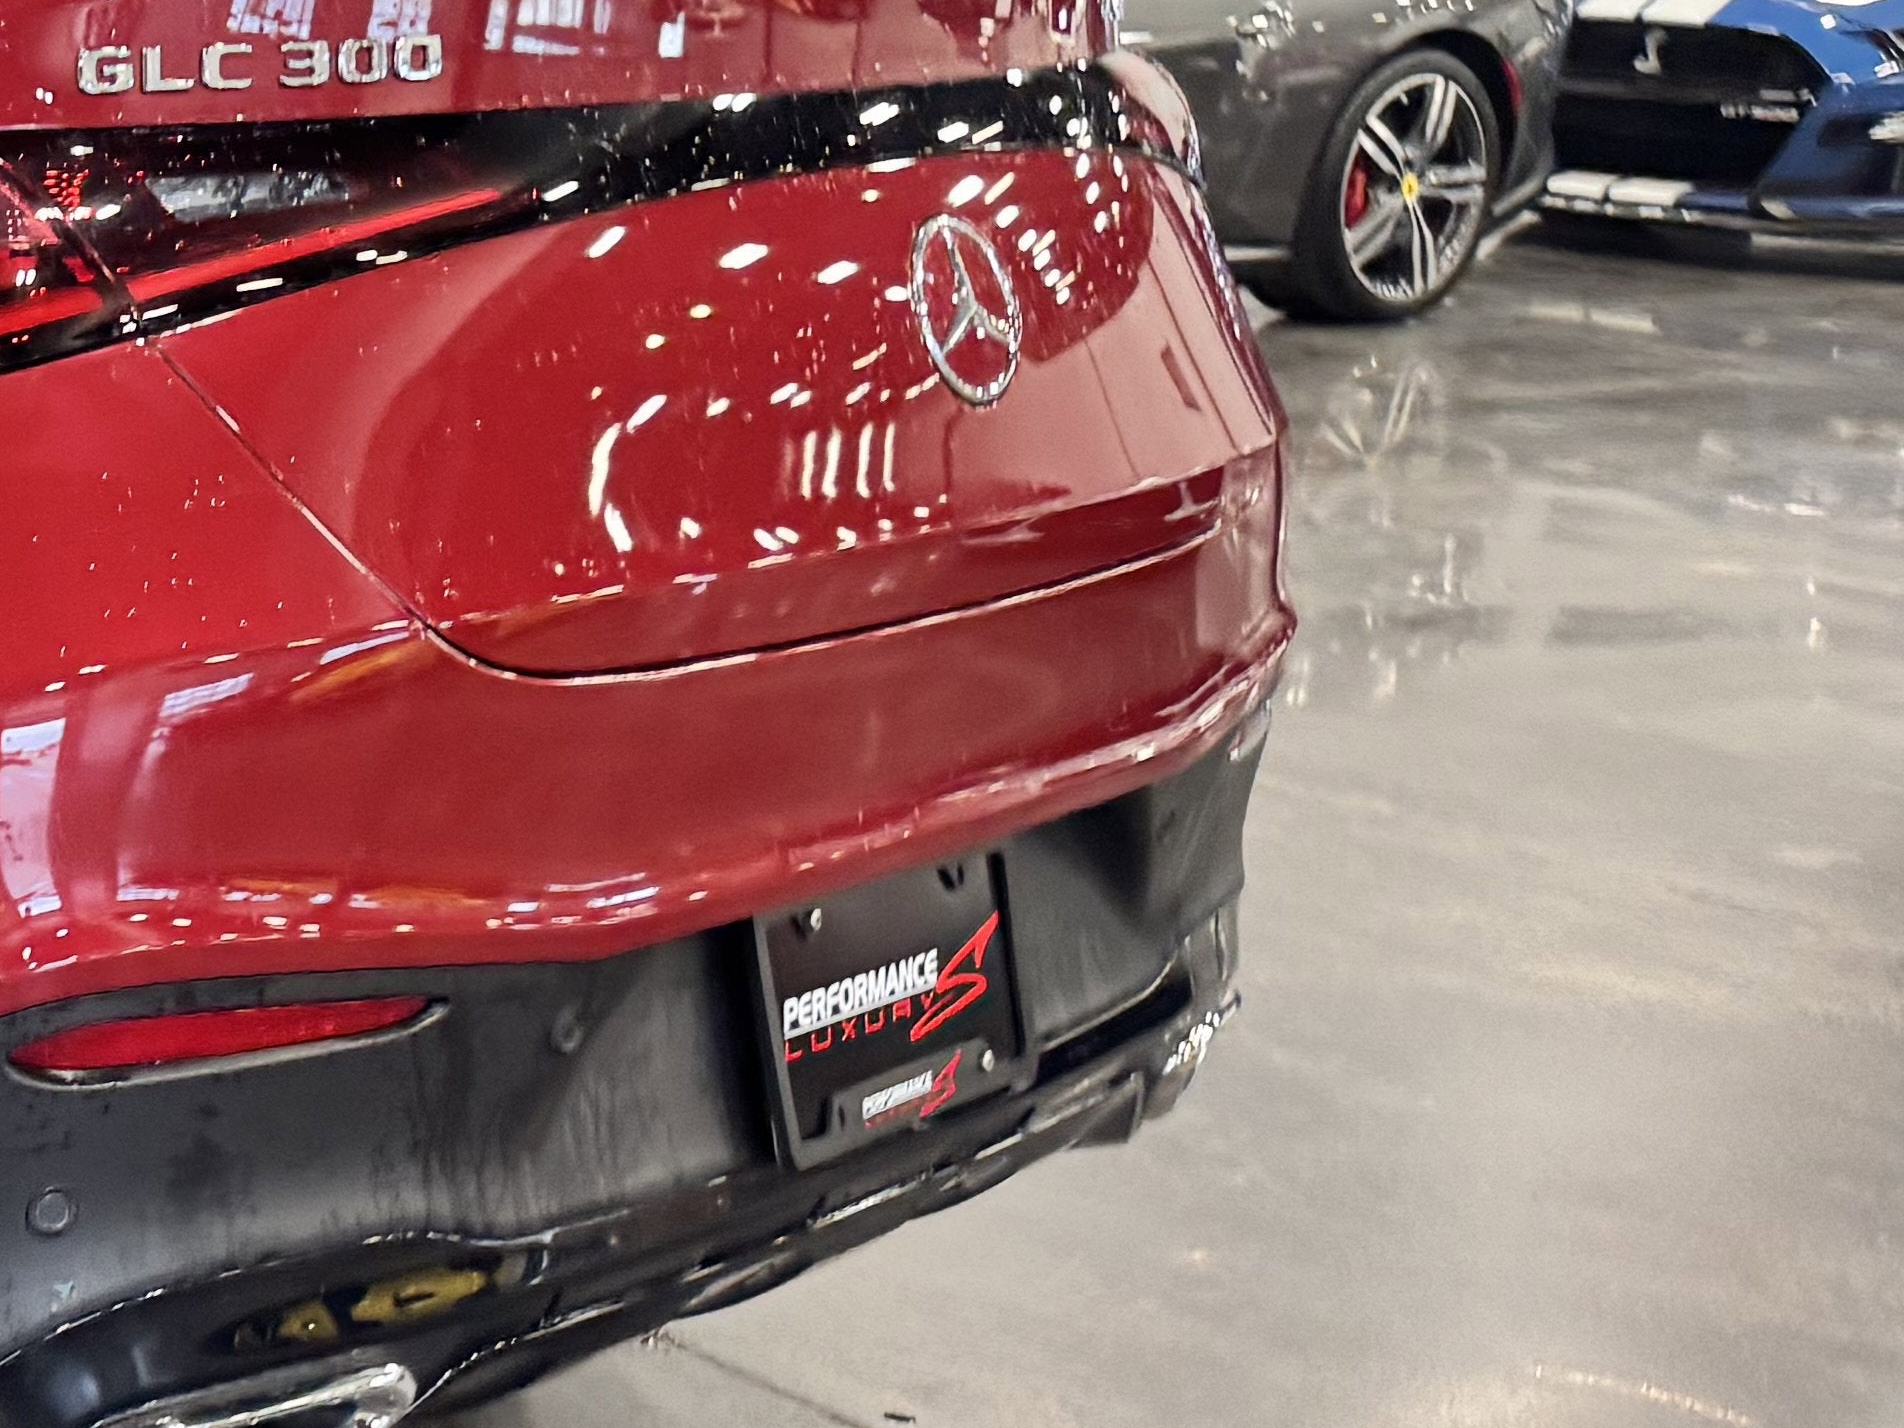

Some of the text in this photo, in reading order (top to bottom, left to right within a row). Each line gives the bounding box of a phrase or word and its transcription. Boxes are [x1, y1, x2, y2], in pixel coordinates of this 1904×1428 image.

[78, 34, 443, 95] GLC 300
[783, 947, 938, 1032] PERFORMANCE
